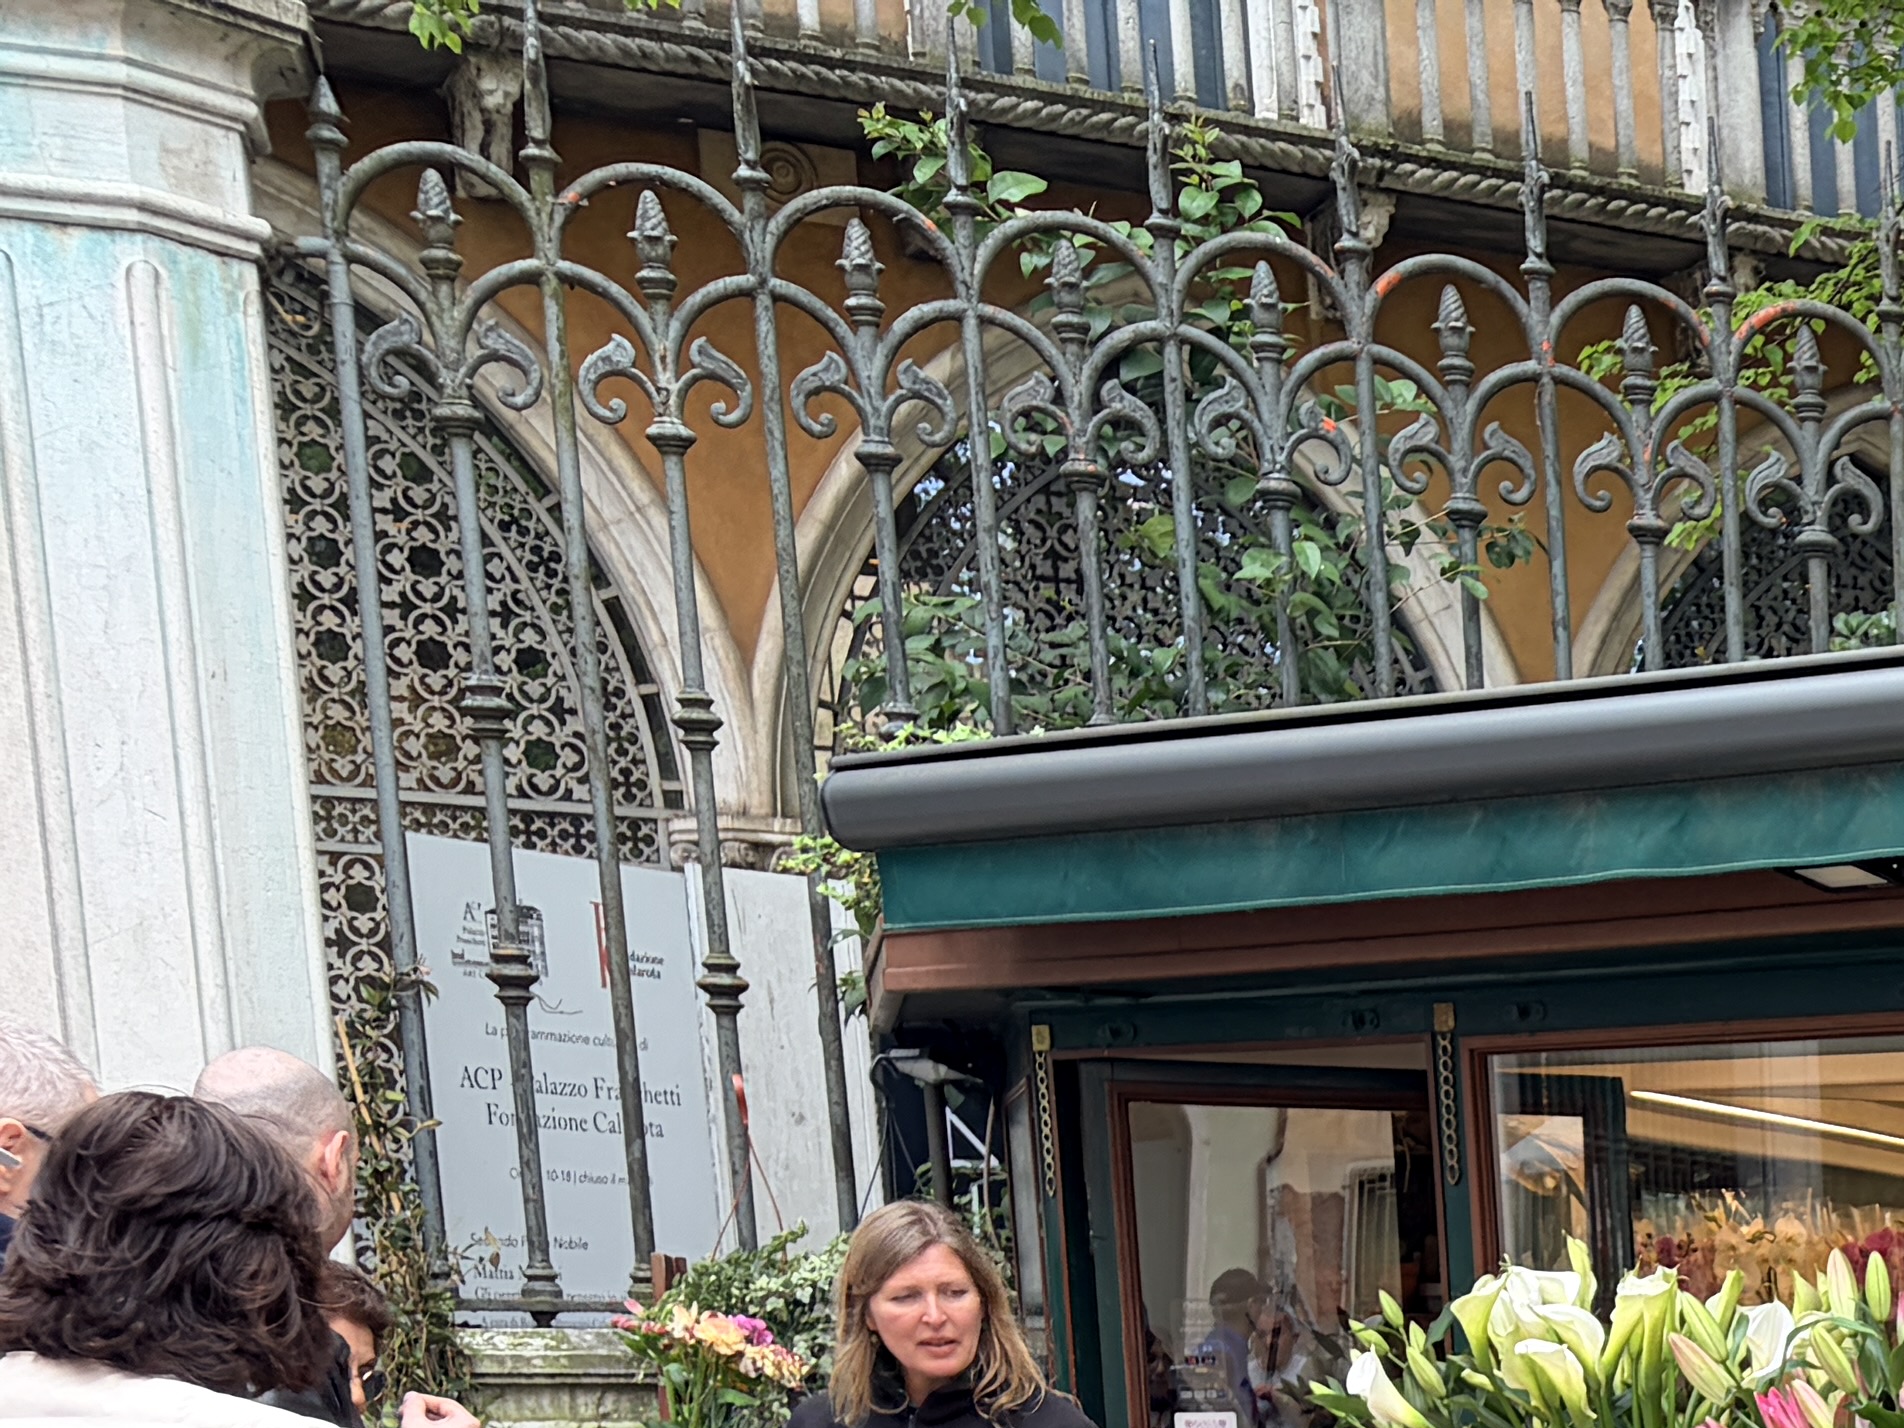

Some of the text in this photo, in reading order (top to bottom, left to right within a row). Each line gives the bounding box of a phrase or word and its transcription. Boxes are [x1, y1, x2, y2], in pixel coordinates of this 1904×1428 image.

[460, 1065, 682, 1107] ACP alazzo Frahetti
